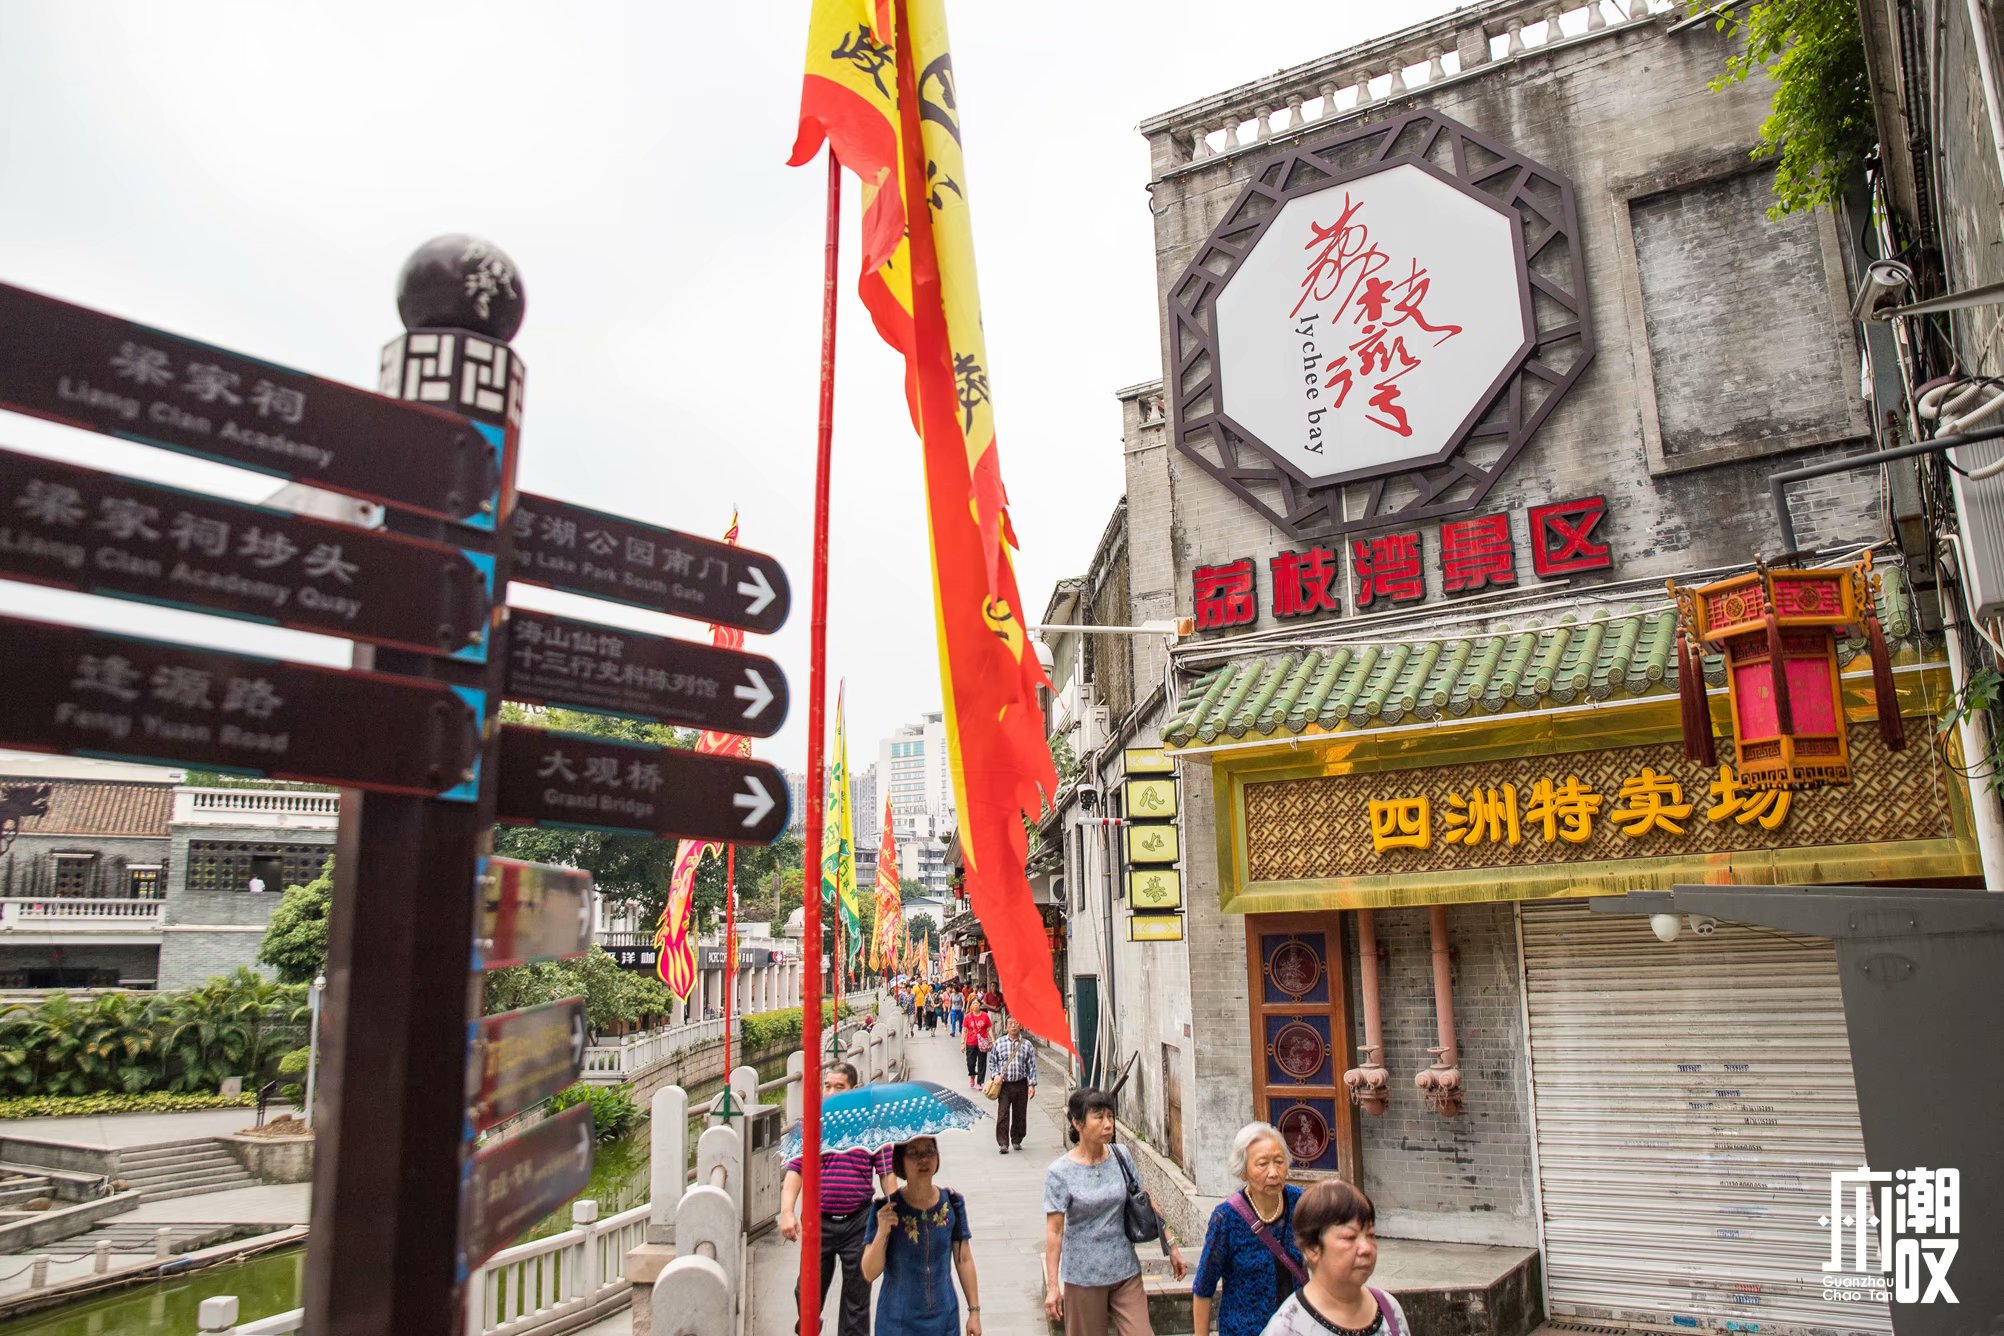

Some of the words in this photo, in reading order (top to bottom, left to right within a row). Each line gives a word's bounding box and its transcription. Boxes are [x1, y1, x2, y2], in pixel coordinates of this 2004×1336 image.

[110, 342, 305, 424] 梁家祠
[1295, 313, 1323, 400] lychee
[57, 376, 141, 420] Liang
[149, 401, 212, 434] Clan
[220, 420, 335, 468] Academy
[1305, 407, 1327, 455] bay
[0, 527, 86, 568] Liang
[96, 547, 163, 578] Clan
[171, 562, 291, 606] Academy
[298, 586, 361, 618] Quay
[536, 552, 577, 572] Lake
[582, 562, 617, 582] Park
[623, 571, 667, 593] South
[672, 583, 705, 602] Gate
[1192, 495, 1614, 632] 荔枝湾景区
[219, 724, 289, 752] Road
[537, 750, 664, 793] 大观桥
[544, 788, 598, 809] Grand
[600, 795, 654, 817] Bridge
[1369, 765, 1792, 853] 四洲特卖场
